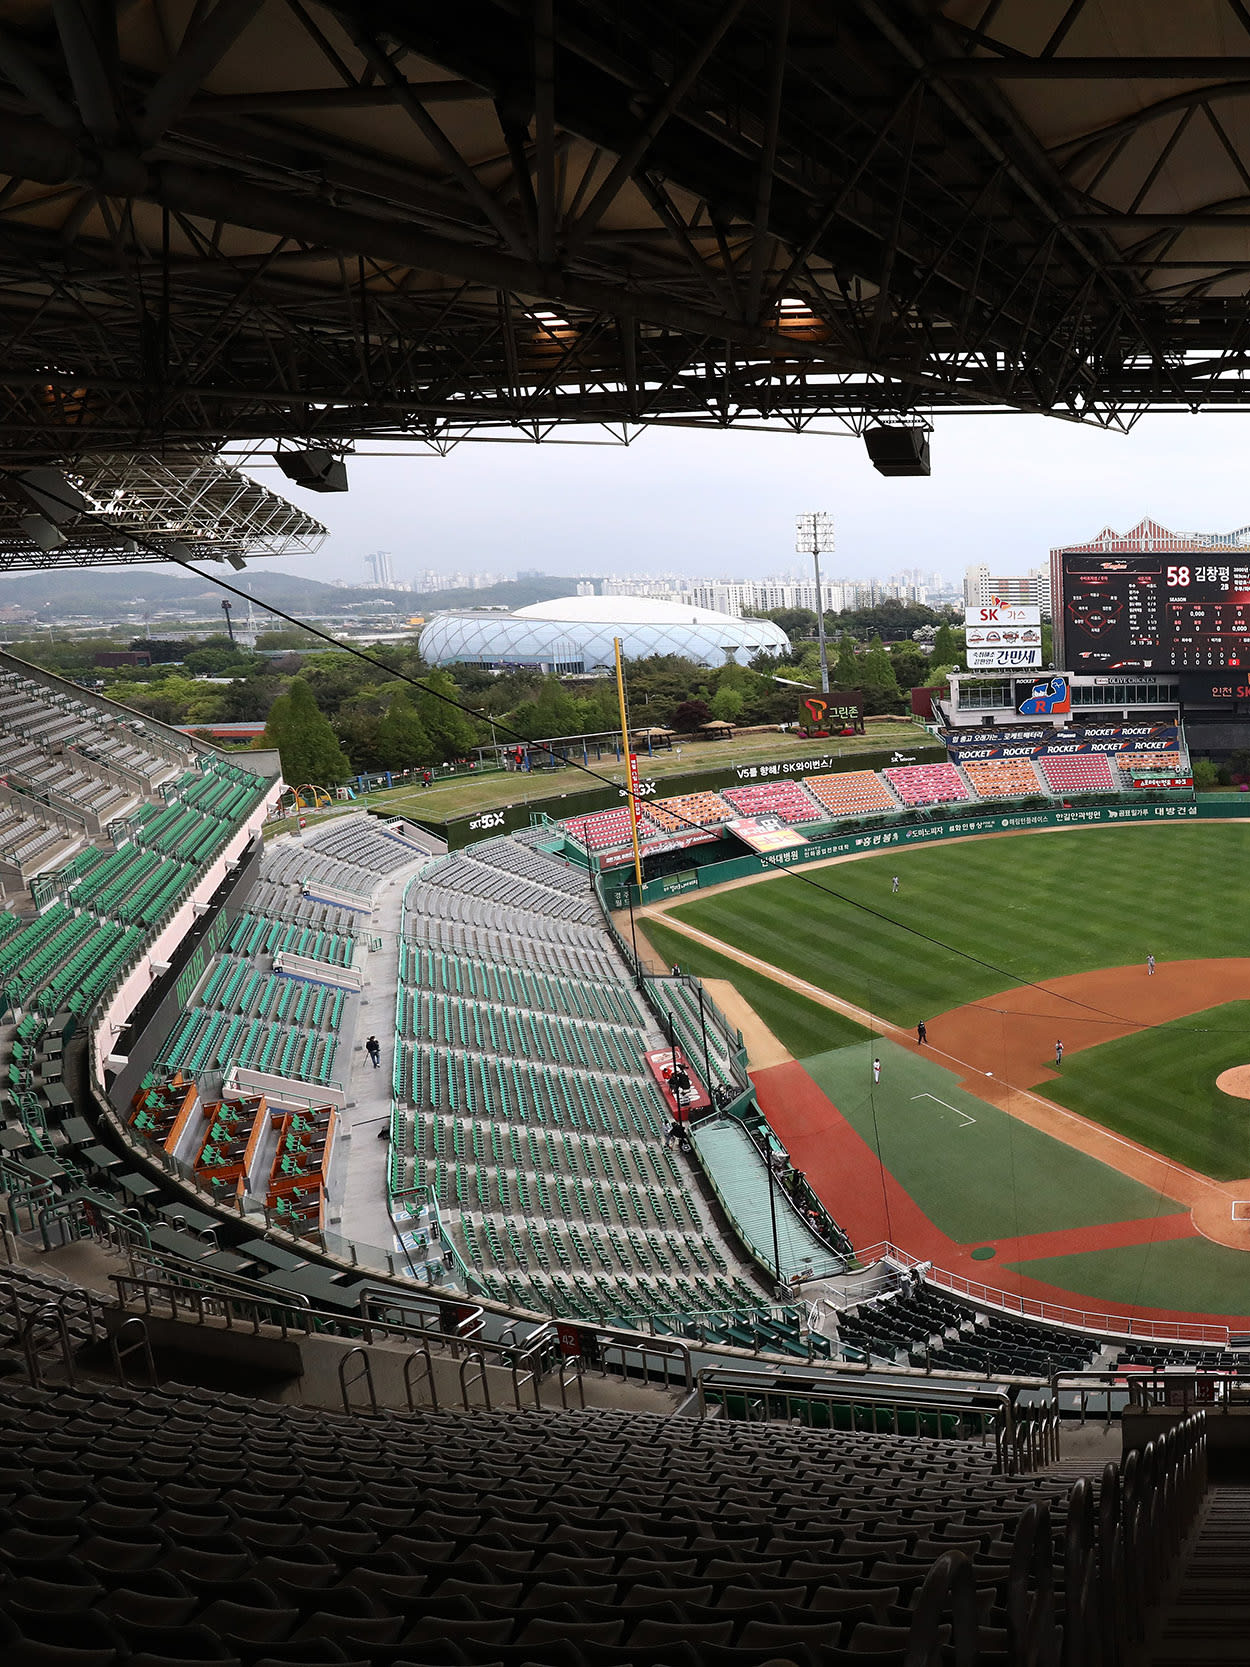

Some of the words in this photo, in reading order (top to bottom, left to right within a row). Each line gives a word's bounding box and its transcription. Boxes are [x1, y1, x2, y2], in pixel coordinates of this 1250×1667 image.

[1166, 566, 1190, 587] 58
[1194, 566, 1230, 582] 김창평
[980, 609, 999, 621] SK
[1007, 610, 1026, 620] 가스
[997, 650, 1036, 665] 간만세
[1212, 687, 1232, 697] 인천
[829, 706, 859, 719] 그린존
[1004, 731, 1043, 740] 로케트배터리
[1085, 728, 1115, 737] ROCKET
[1122, 727, 1152, 736] ROCKET
[958, 750, 992, 759] ROCKET
[1003, 747, 1036, 756] ROCKET
[1047, 744, 1080, 754] ROCKET
[1091, 743, 1124, 752] ROCKET
[1135, 741, 1168, 750] ROCKET
[736, 766, 758, 779] V5를
[760, 765, 781, 776] 향해!
[782, 758, 833, 772] SK와이번스!
[1056, 810, 1101, 822] 한길안과병원
[1155, 806, 1198, 816] 대방건설
[469, 820, 482, 830] SKT
[481, 811, 505, 829] 5GX
[912, 826, 944, 838] 도미노피자
[562, 1335, 576, 1346] 42
